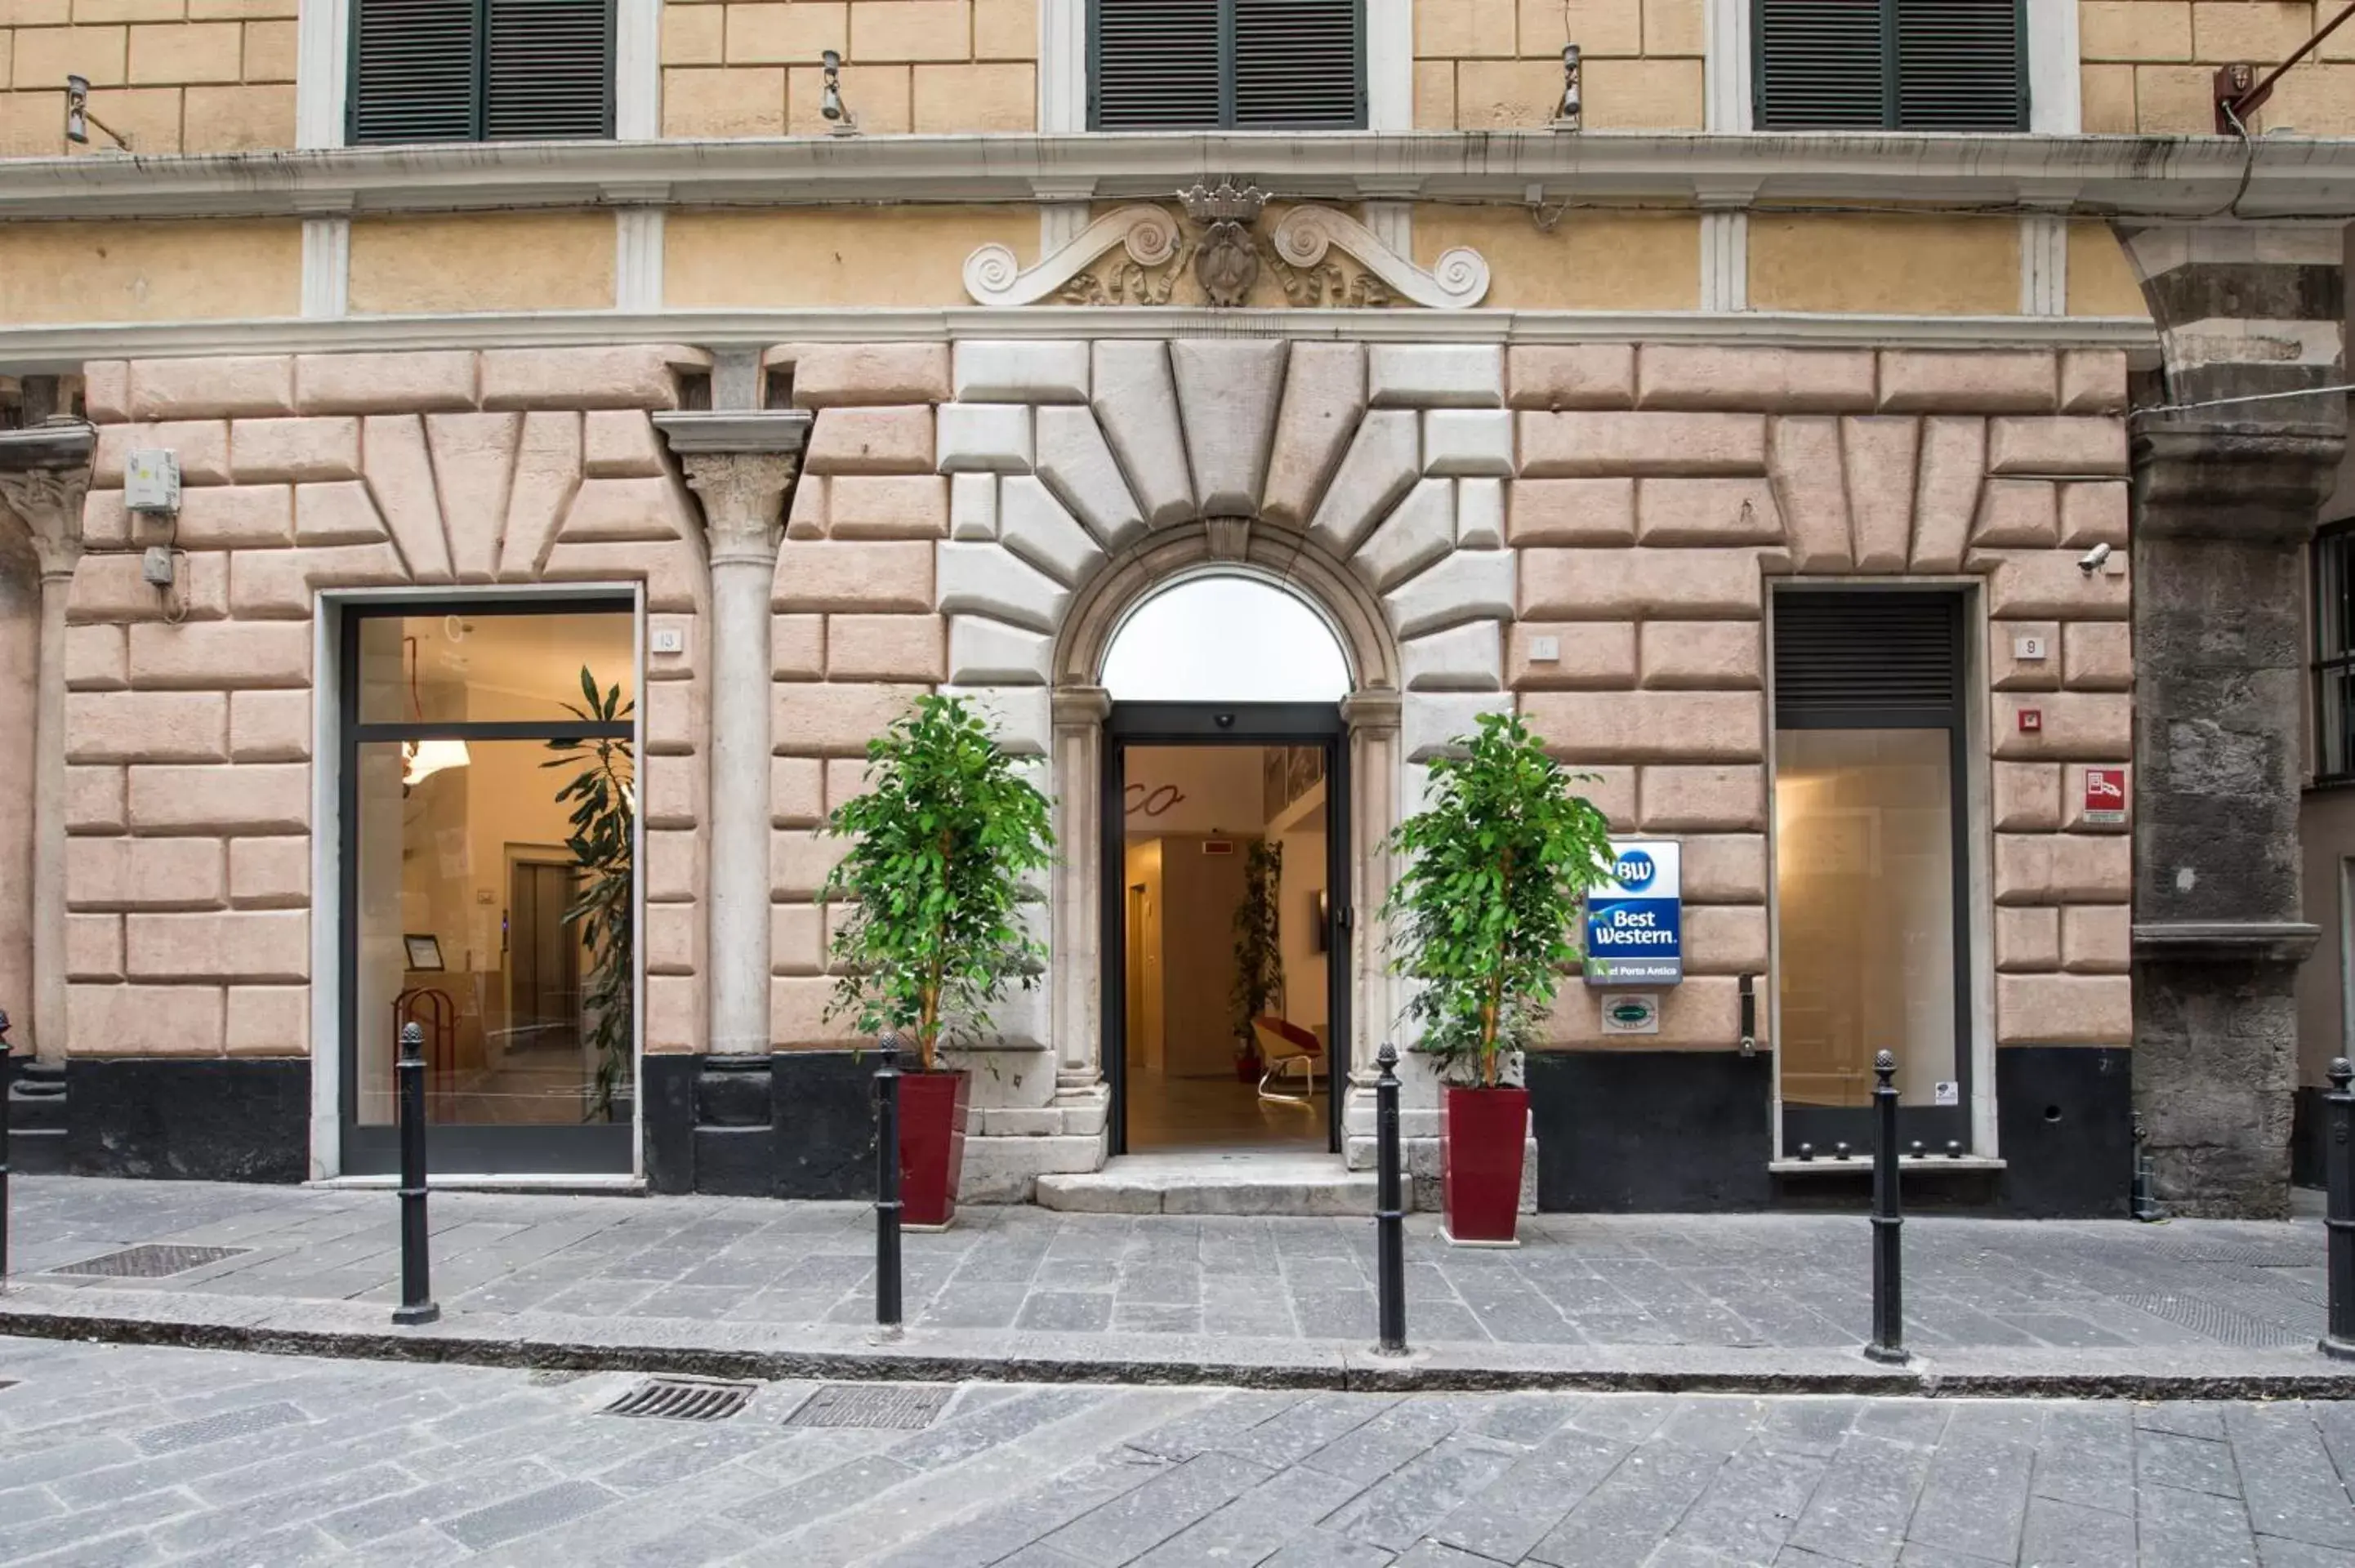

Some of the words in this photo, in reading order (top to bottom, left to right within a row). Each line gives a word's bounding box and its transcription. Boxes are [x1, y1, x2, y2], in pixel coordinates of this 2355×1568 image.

[1617, 861, 1652, 880] BW
[1614, 910, 1656, 927] Best
[1595, 927, 1673, 944] Western
